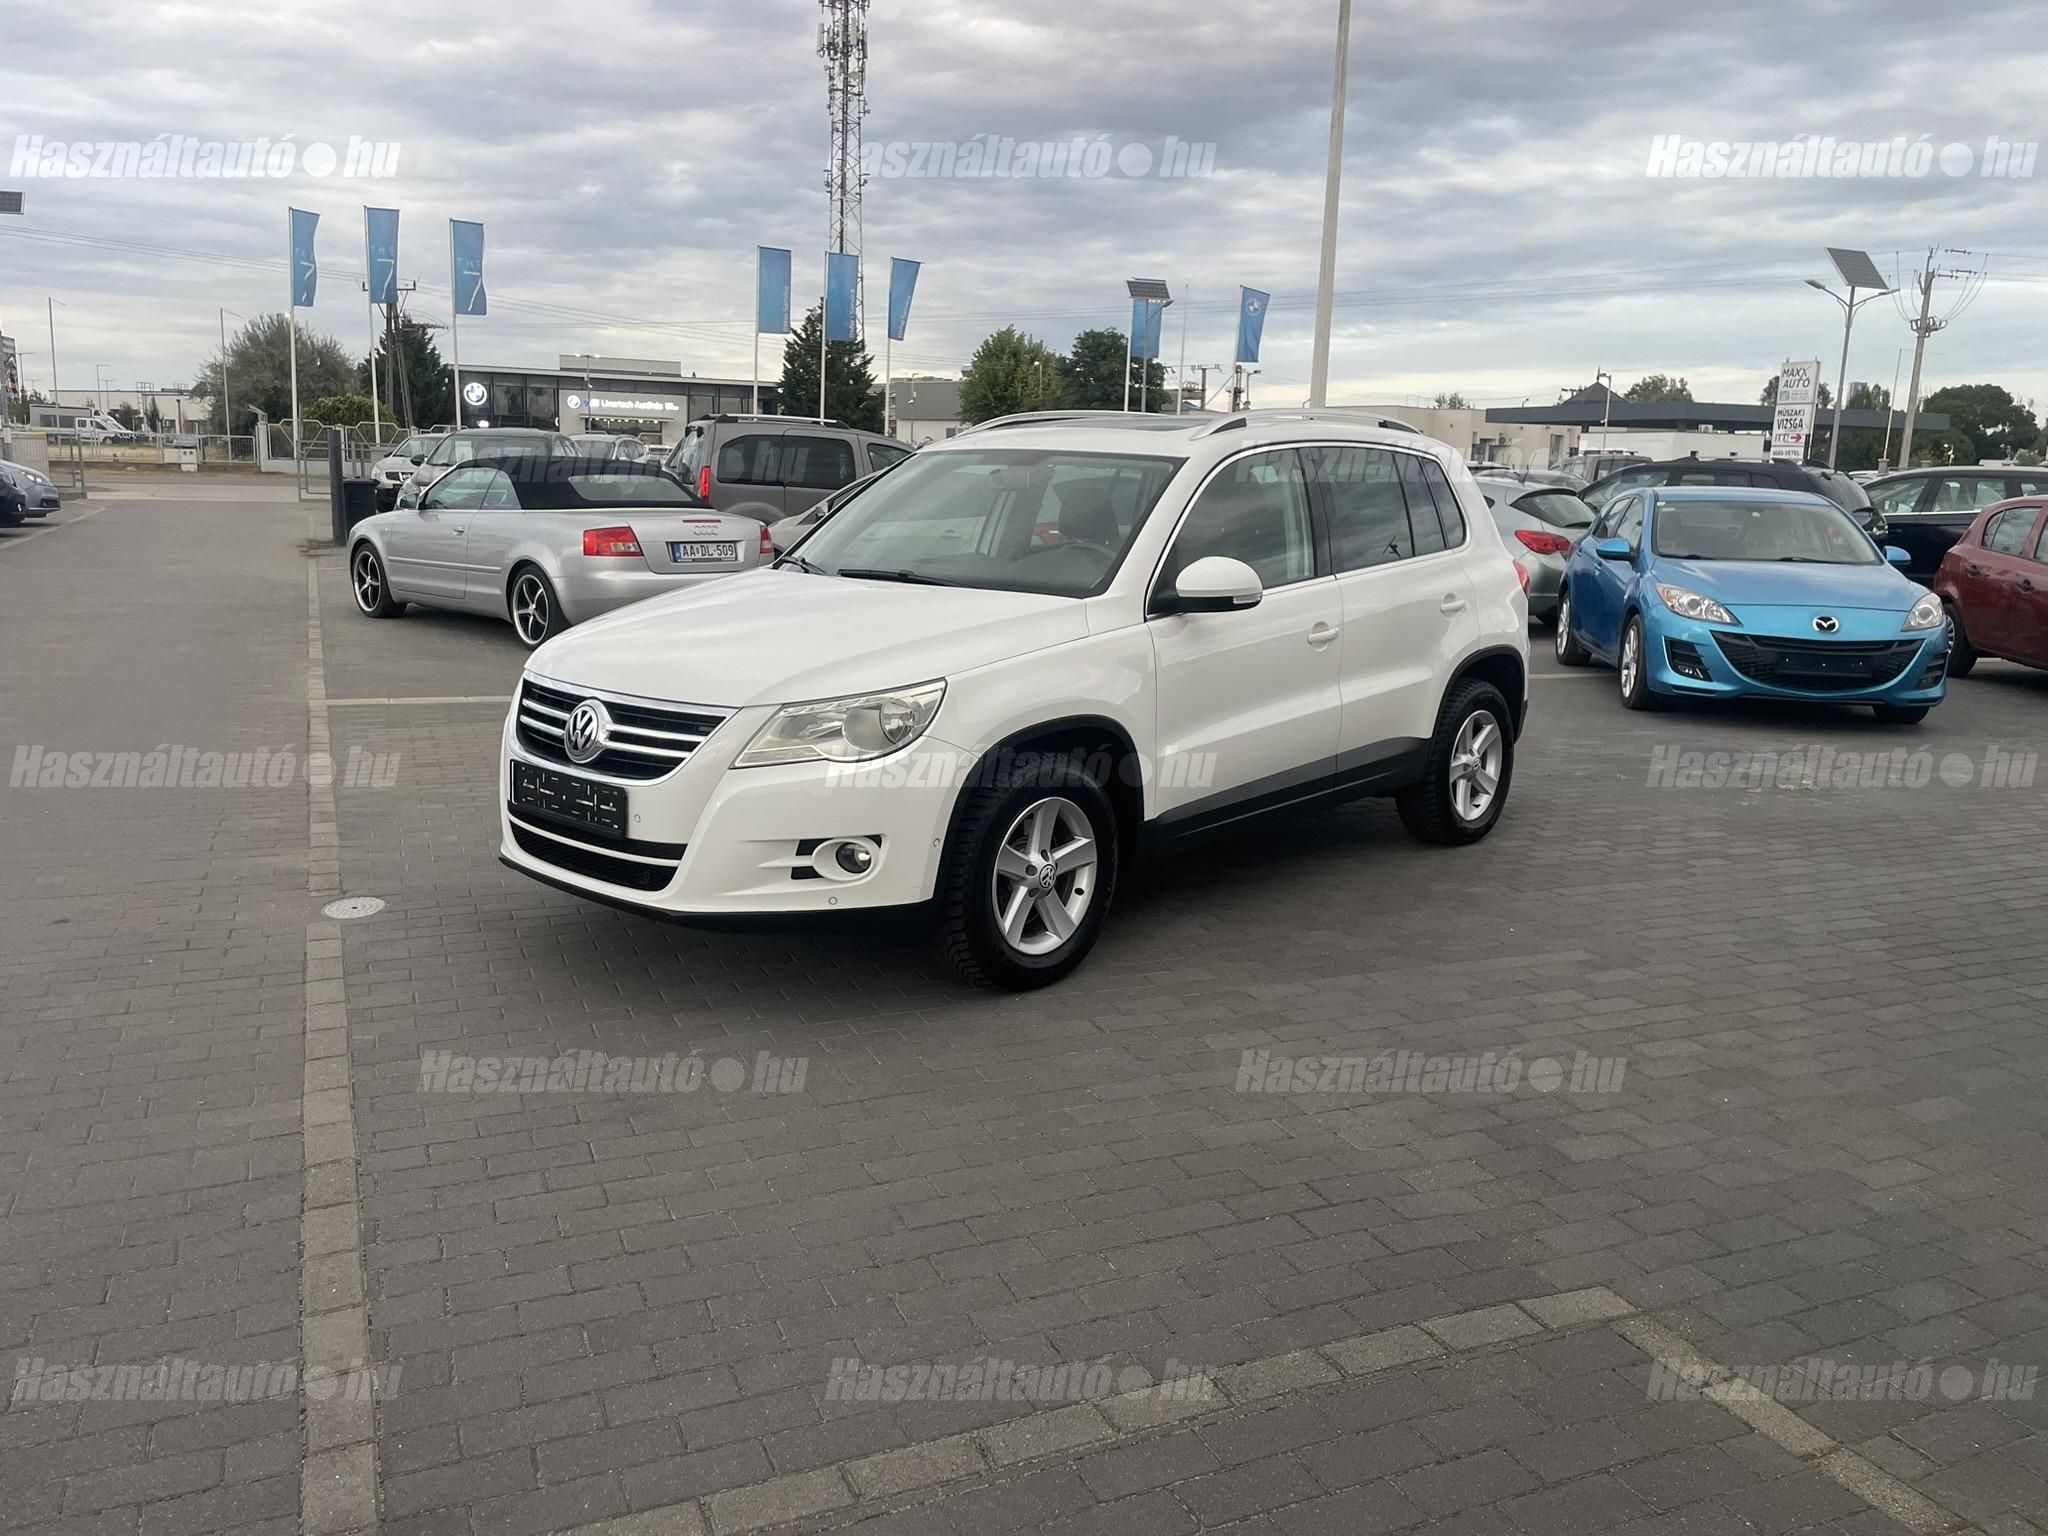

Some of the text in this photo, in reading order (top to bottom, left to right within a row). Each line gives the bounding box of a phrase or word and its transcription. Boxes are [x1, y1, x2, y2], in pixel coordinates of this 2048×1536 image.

[377, 258, 395, 300] 7
[463, 270, 482, 312] 7
[1782, 366, 1809, 378] MAXX
[1776, 419, 1804, 430] VIZSGA
